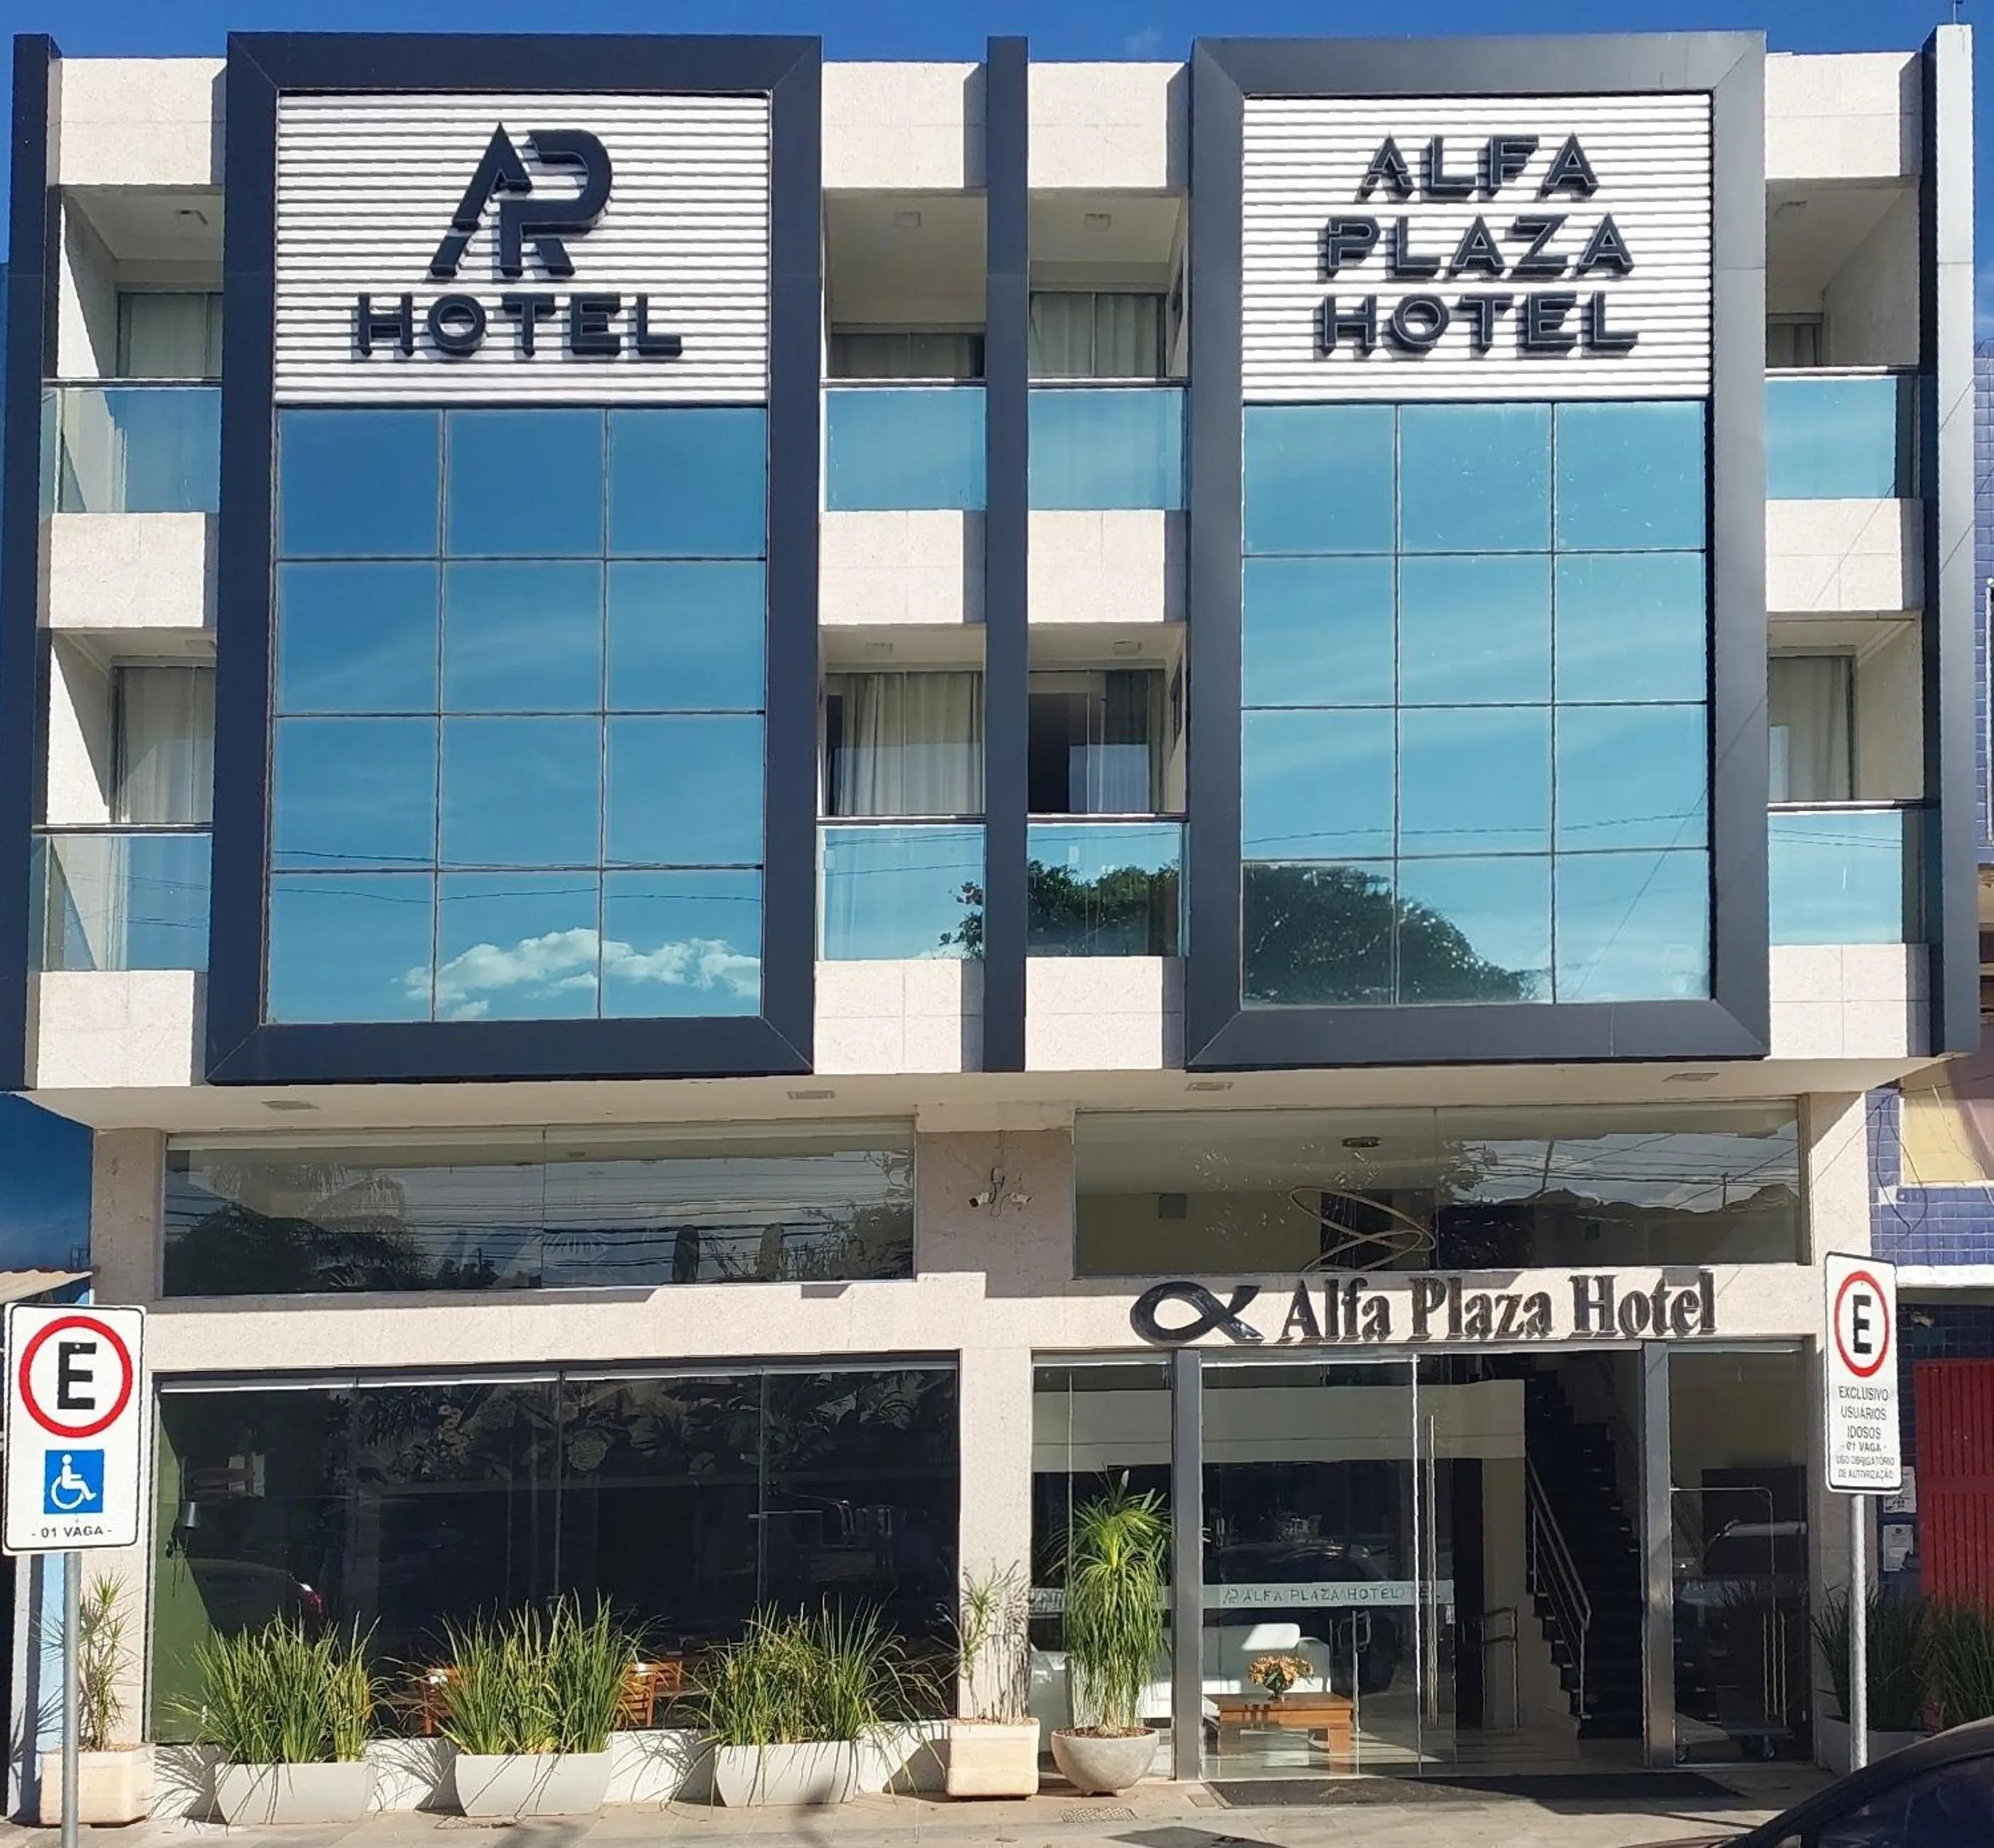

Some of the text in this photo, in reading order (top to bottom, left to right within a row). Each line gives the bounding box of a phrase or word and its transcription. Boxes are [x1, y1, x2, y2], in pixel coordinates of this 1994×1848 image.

[1355, 132, 1599, 202] ALFA
[1320, 212, 1634, 279] PLAZA
[356, 292, 683, 357] HOTEL
[1318, 290, 1638, 357] HOTEL
[1278, 1269, 1716, 1343] Alfa Plaza Hotel
[1853, 1294, 1872, 1355] E
[57, 1341, 97, 1410] E
[1838, 1385, 1888, 1401] EXCLUSIVO
[1847, 1425, 1882, 1440] IDOSOS
[1858, 1442, 1882, 1452] VAGA
[1838, 1468, 1846, 1478] DE
[41, 1527, 57, 1539] 01
[64, 1525, 104, 1537] VAGA
[1243, 1588, 1283, 1602] ALFA
[1290, 1588, 1340, 1602] PLAZA
[1348, 1588, 1400, 1600] HOTEL
